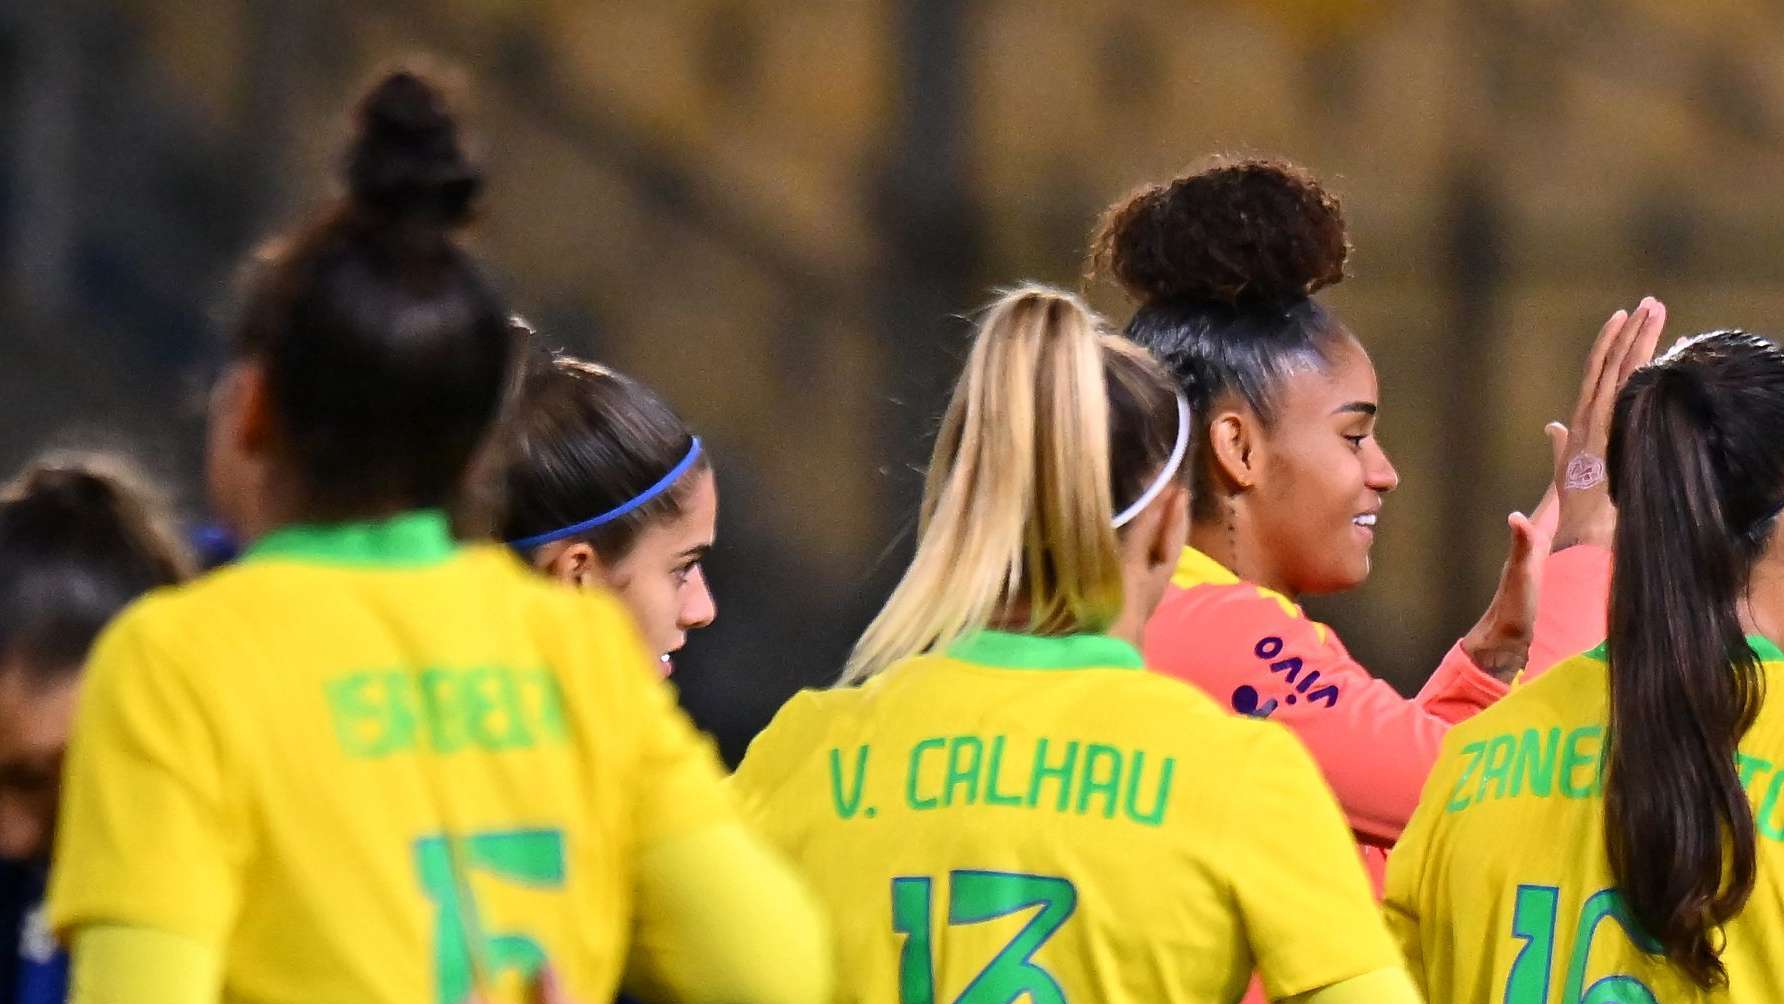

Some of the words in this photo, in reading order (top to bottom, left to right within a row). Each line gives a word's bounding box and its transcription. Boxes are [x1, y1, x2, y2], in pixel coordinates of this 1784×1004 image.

[1254, 636, 1339, 708] vivo
[829, 744, 879, 820] V.
[906, 734, 1177, 828] CALHAU
